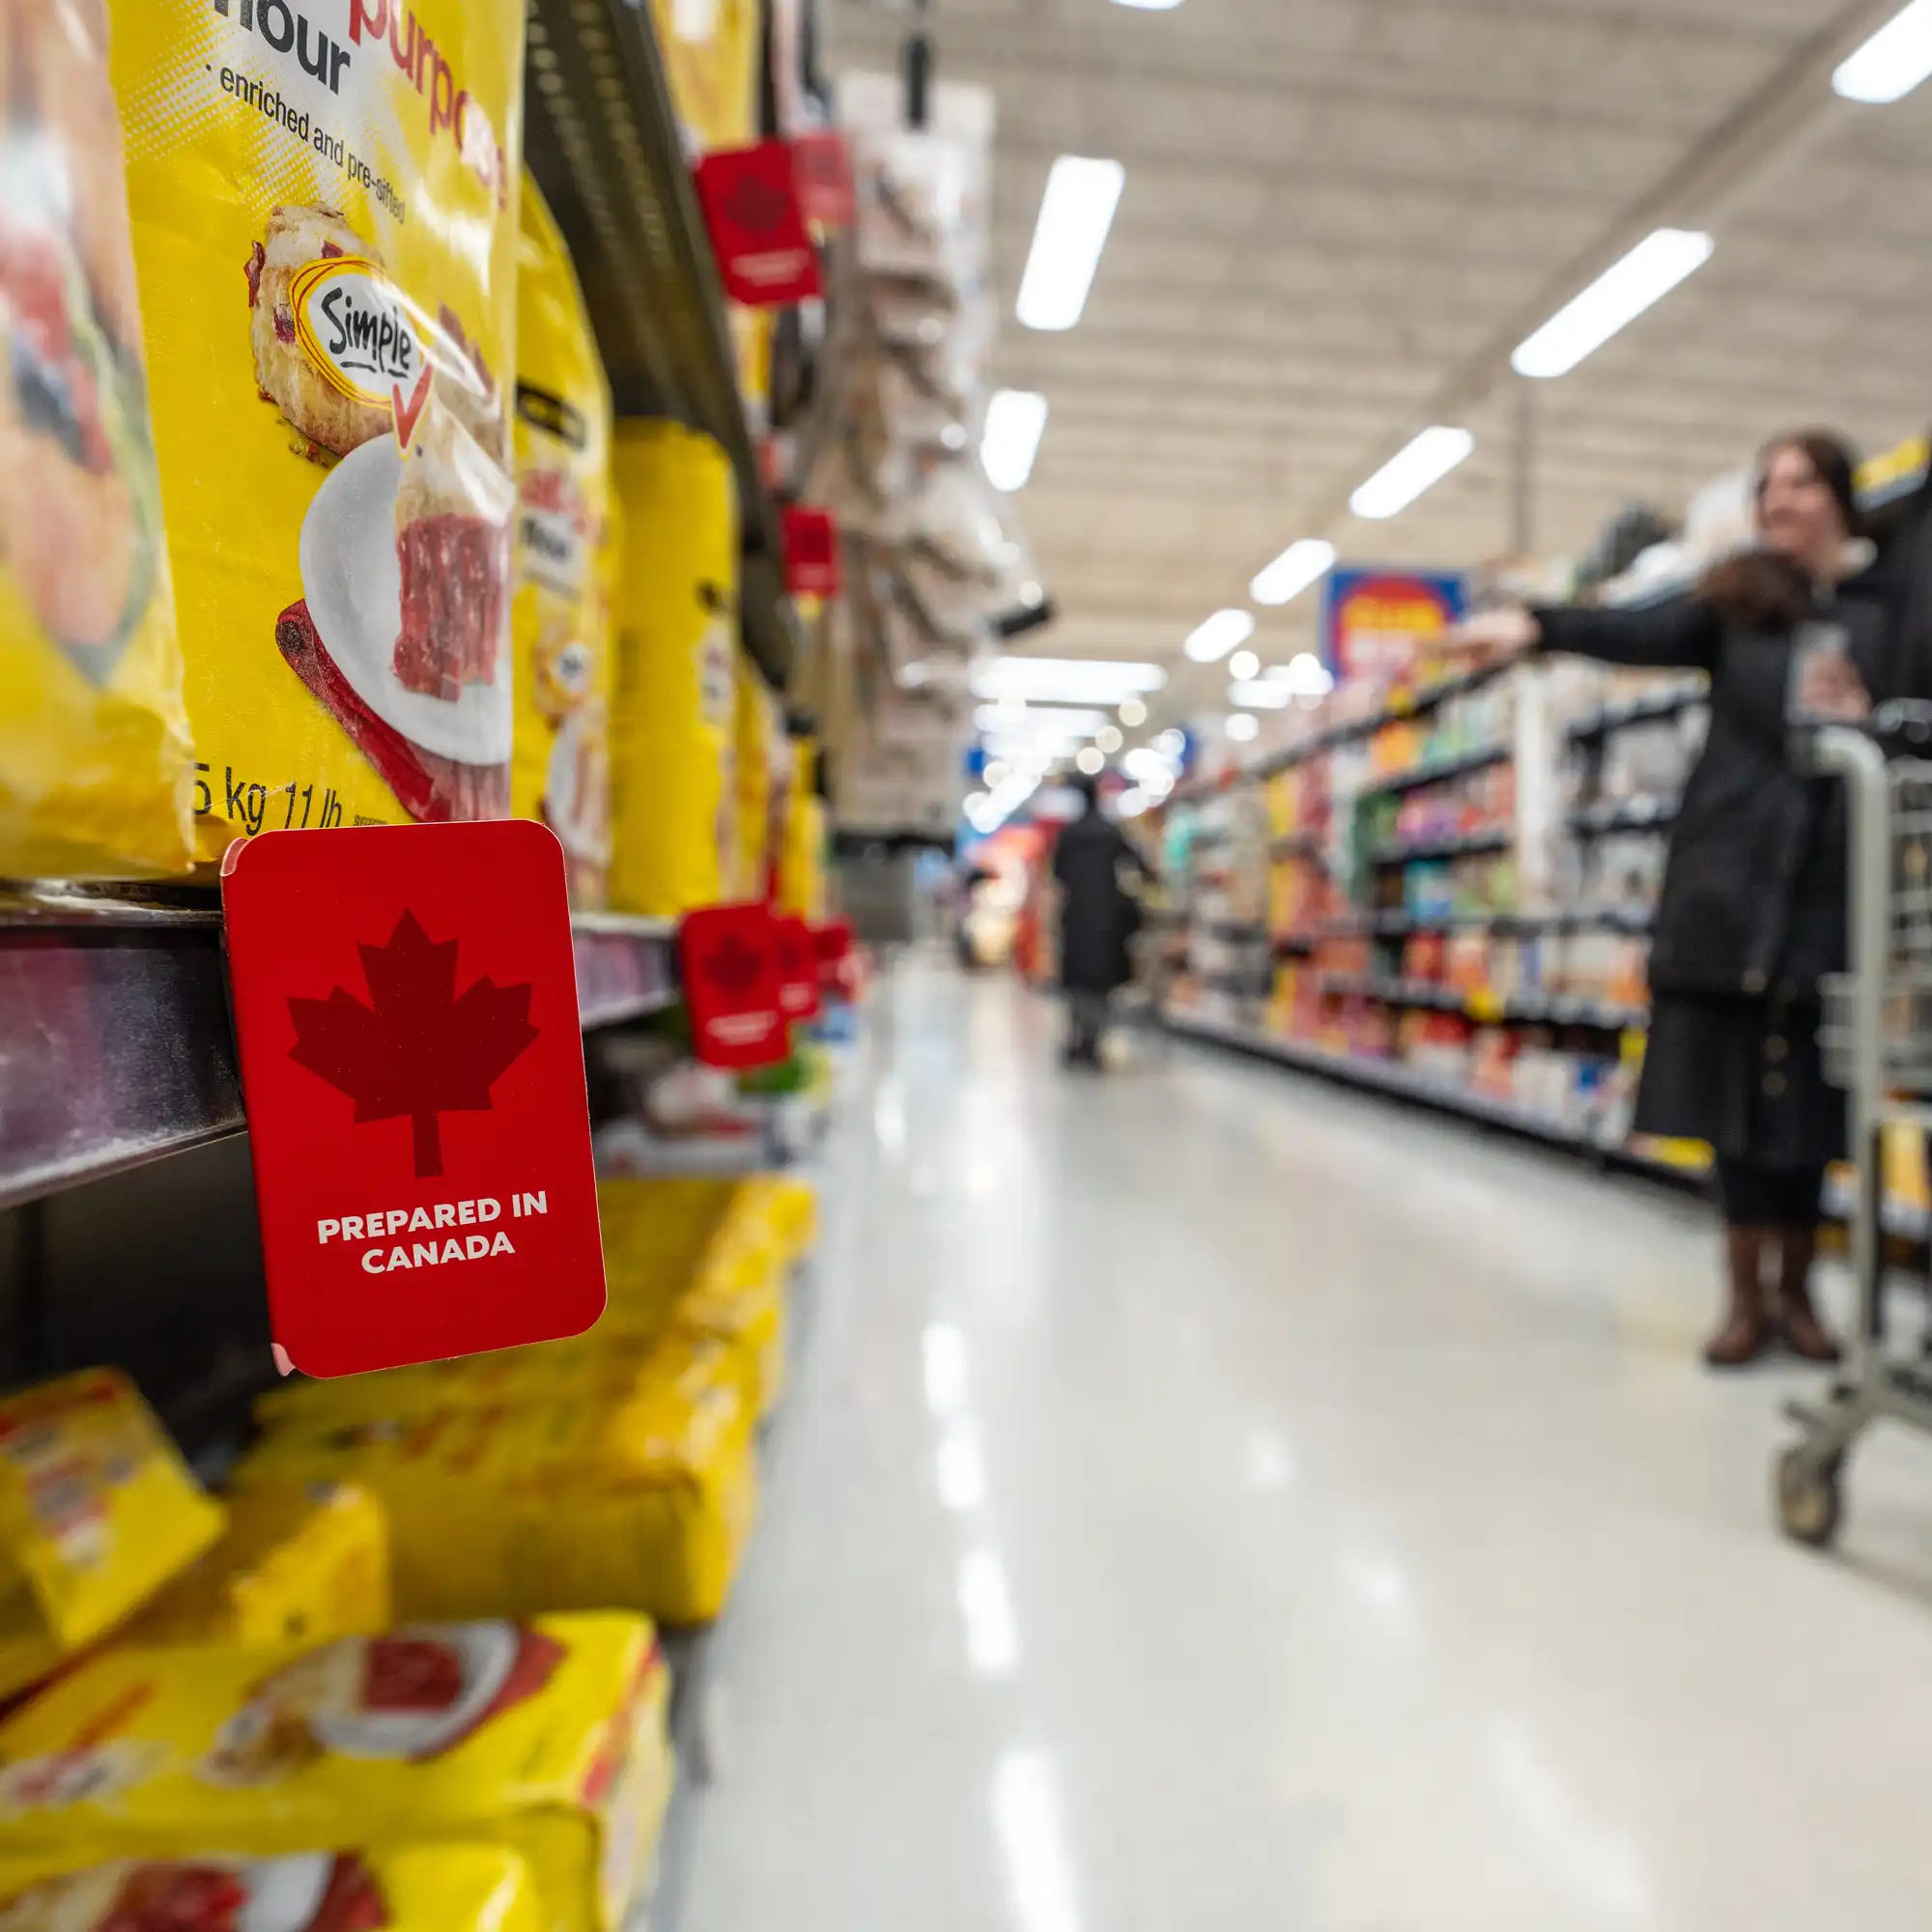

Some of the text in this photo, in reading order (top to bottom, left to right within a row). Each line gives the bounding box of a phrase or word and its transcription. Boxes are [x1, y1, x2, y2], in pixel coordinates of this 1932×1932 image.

[214, 0, 352, 96] our
[220, 66, 406, 225] enriched and pre-sifted
[321, 287, 412, 373] Simple
[225, 766, 267, 836] kg
[285, 781, 313, 829] 11
[320, 788, 342, 828] lb
[317, 1190, 548, 1244] PREPARED IN
[361, 1232, 516, 1274] CANADA
